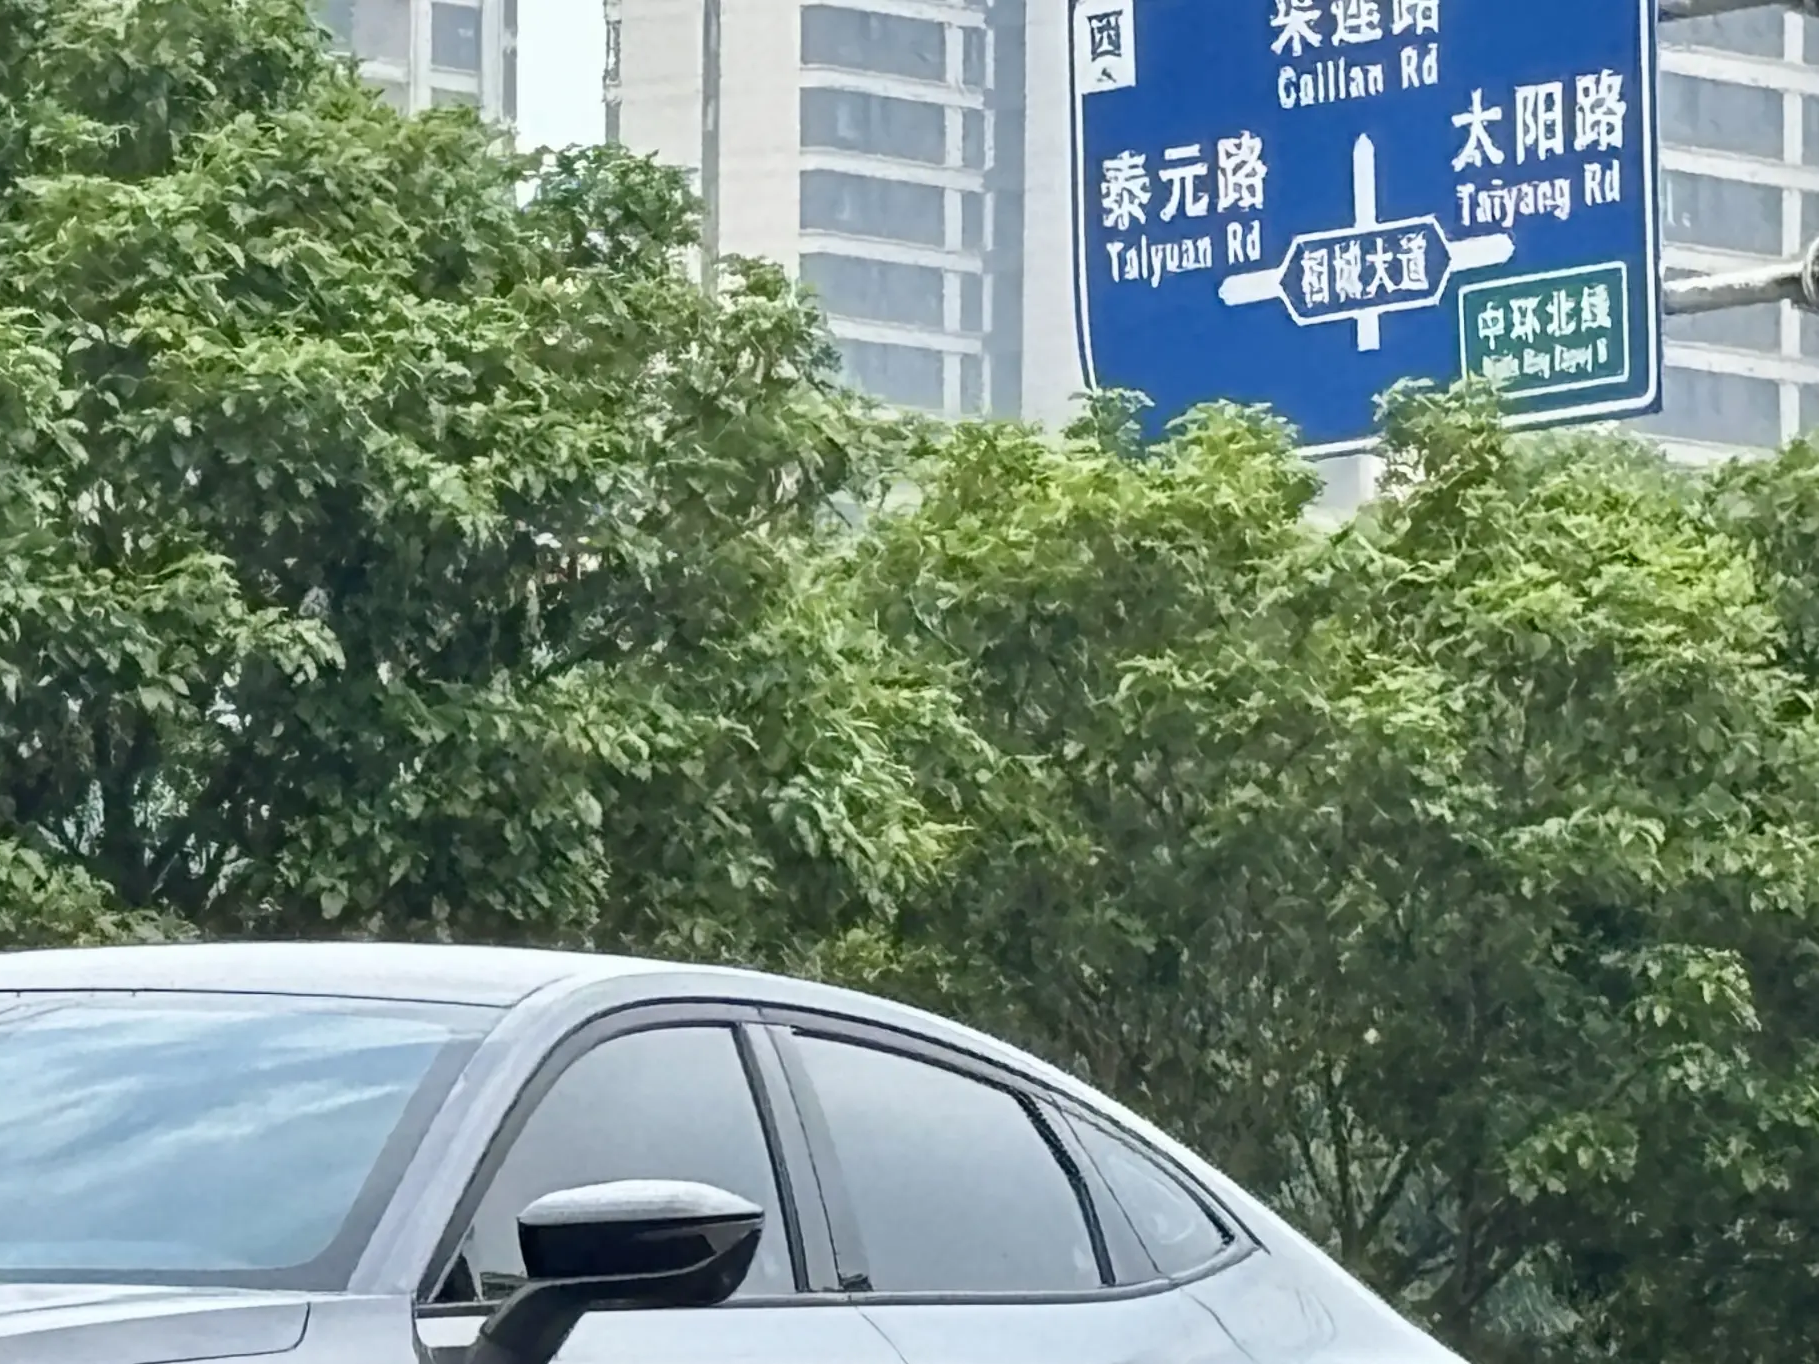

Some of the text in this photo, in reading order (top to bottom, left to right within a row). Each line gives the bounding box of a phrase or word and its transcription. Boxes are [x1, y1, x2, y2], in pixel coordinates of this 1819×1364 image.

[1400, 43, 1439, 90] Rd
[1451, 69, 1627, 172] 太阳路
[1100, 130, 1268, 230] 泰元路
[1456, 159, 1621, 228] Taiyang Rd
[1226, 220, 1261, 265] Rd
